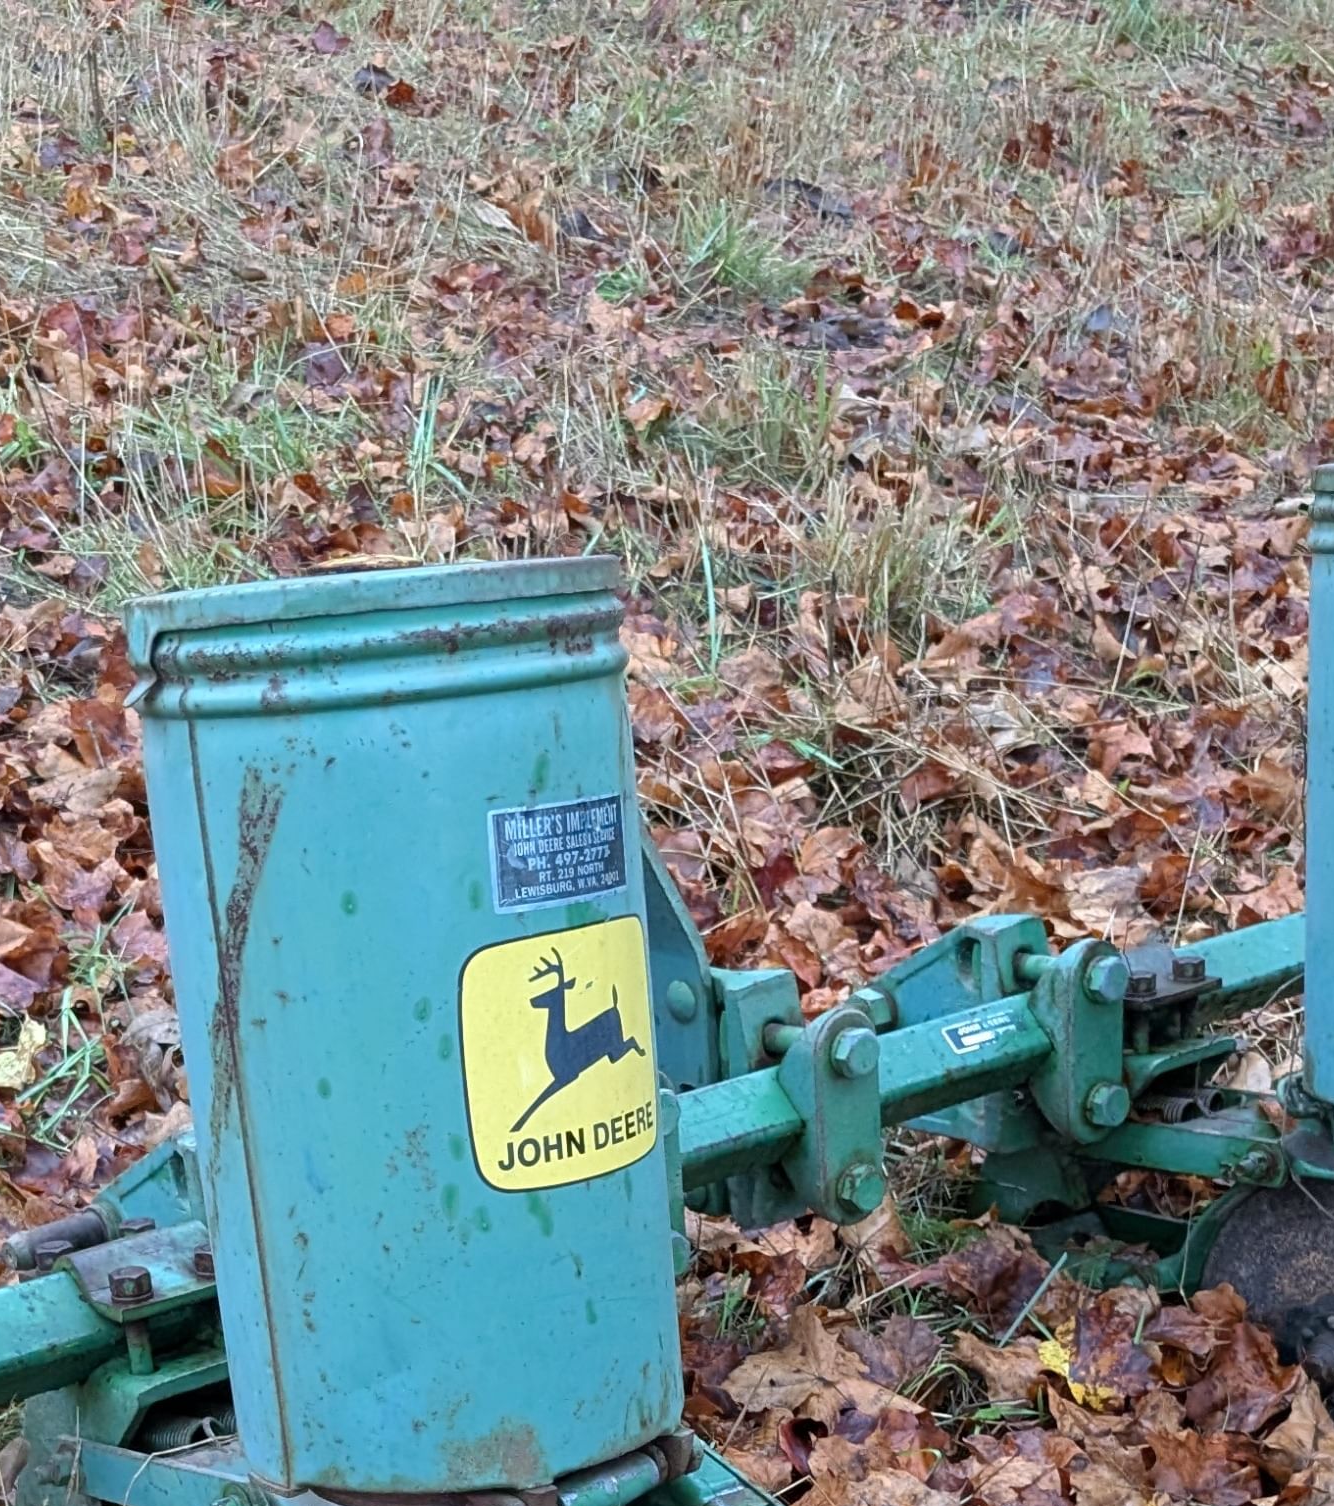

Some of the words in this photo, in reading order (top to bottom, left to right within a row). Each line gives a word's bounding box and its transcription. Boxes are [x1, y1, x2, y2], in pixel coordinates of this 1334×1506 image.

[504, 814, 563, 841] MILLER'S
[567, 803, 617, 832] IMPLEMENT
[513, 841, 536, 857] JOHN
[538, 837, 564, 853] DEERE
[566, 834, 587, 849] SALES
[528, 856, 550, 871] PH.
[539, 870, 555, 883] RT.
[558, 867, 574, 879] 219
[577, 862, 604, 875] NORTH
[515, 880, 575, 899] LEWISBURG,
[498, 1128, 585, 1171] JOHN
[593, 1101, 653, 1150] DEERE
